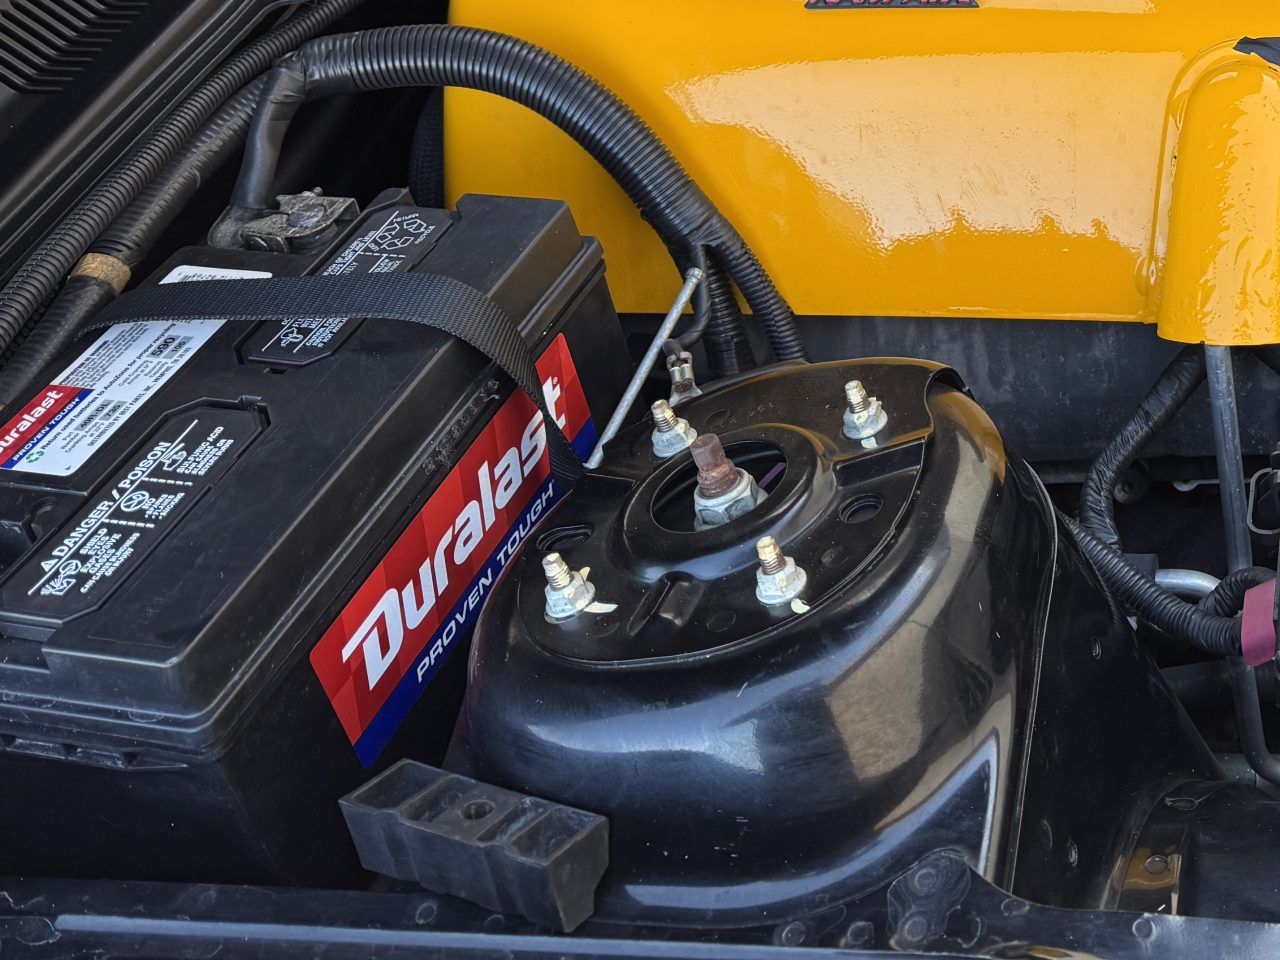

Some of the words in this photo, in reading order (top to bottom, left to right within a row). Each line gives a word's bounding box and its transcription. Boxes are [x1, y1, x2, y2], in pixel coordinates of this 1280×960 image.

[152, 337, 176, 357] 590
[42, 431, 61, 450] Return
[60, 420, 73, 436] used
[73, 395, 99, 420] batteries
[96, 387, 105, 397] to
[103, 365, 130, 390] AutoZone
[128, 357, 137, 367] for
[136, 342, 154, 360] proper
[153, 322, 177, 343] recycling
[0, 390, 64, 455] uralast
[12, 426, 50, 461] PROVEN
[49, 396, 80, 426] TOUGH
[80, 401, 112, 428] 40R-DL
[176, 441, 210, 473] SULFURIC
[207, 426, 224, 442] ACID
[52, 501, 114, 556] DANGER
[118, 442, 172, 489] POISON
[80, 528, 108, 554] SHIELD
[80, 533, 122, 573] EXPLOSIVE
[88, 536, 109, 555] EYES
[342, 376, 566, 692] Duralast
[89, 549, 116, 574] GASES
[415, 567, 493, 684] PROVEN
[496, 482, 555, 567] TOUGH
